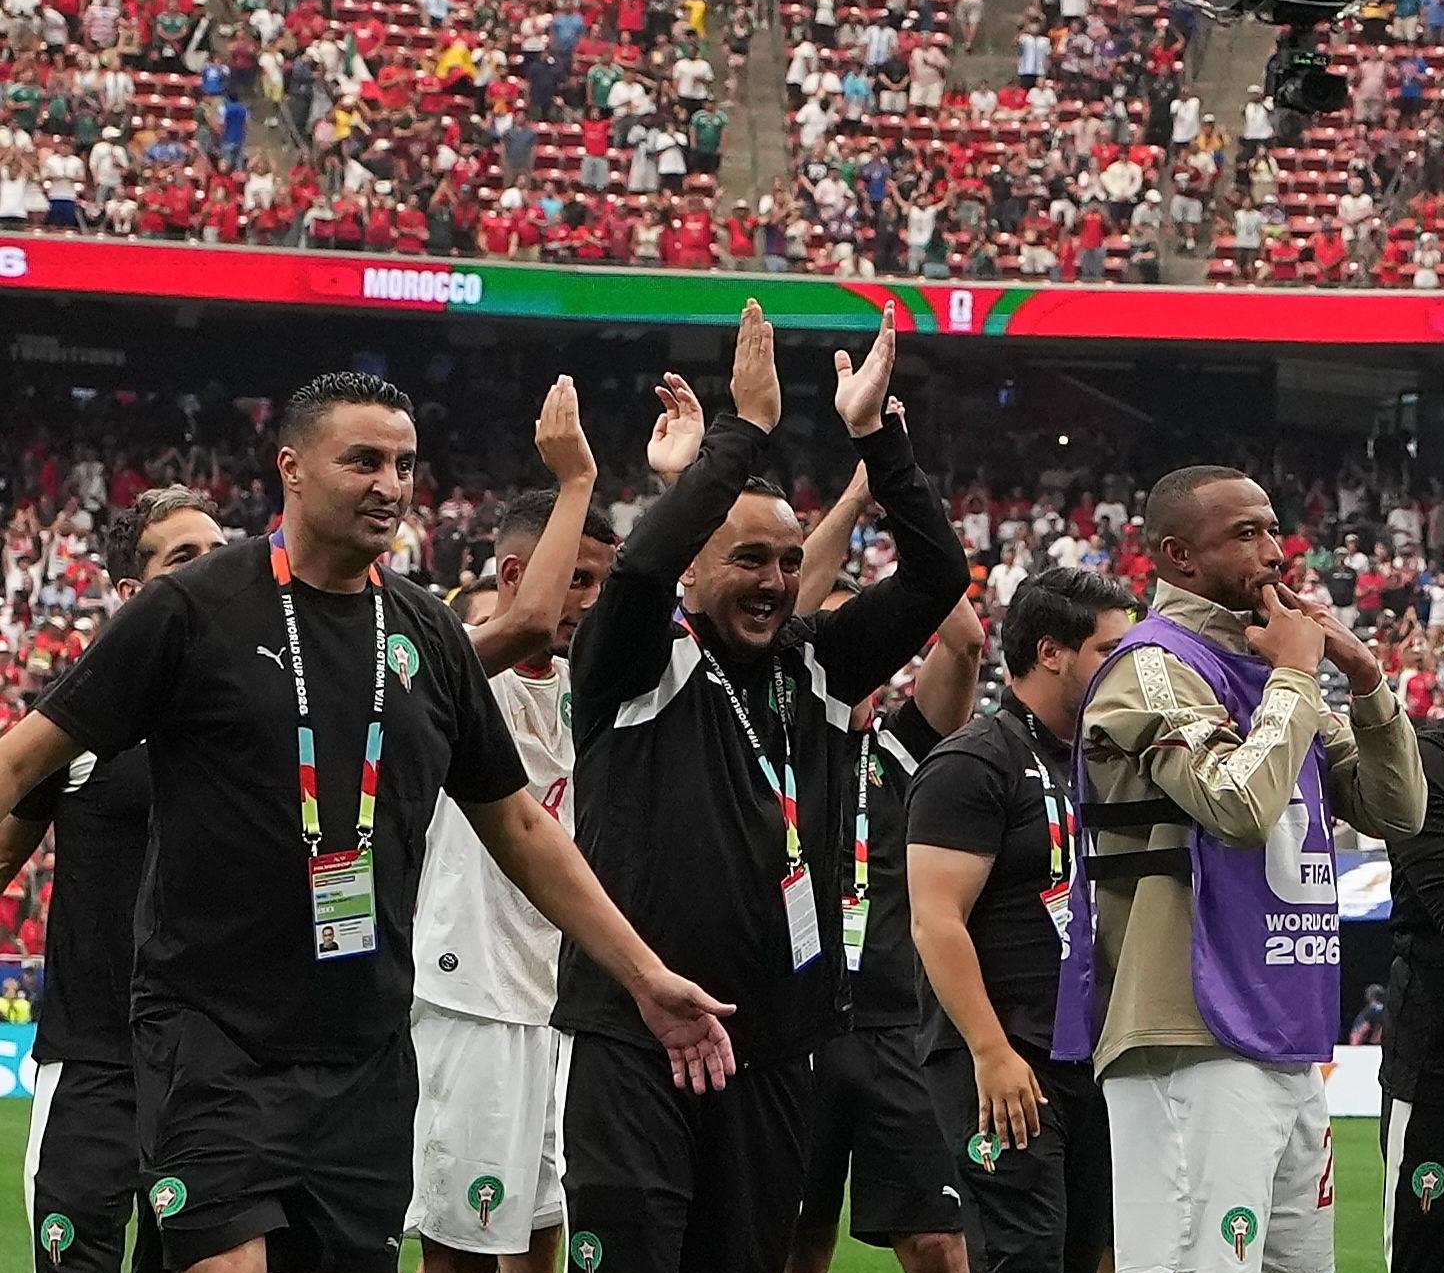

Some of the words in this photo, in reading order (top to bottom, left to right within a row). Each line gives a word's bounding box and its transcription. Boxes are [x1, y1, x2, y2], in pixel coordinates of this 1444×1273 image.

[363, 267, 483, 305] MOROCCO
[281, 594, 295, 617] FIFA
[286, 616, 301, 655] WORLD
[376, 629, 386, 649] CUP
[291, 654, 304, 677] CUP
[375, 649, 386, 688] WORLD
[295, 677, 309, 717] 2026
[373, 688, 385, 712] FIFA
[721, 677, 735, 697] CUP
[730, 695, 751, 731] WORLD
[1300, 864, 1331, 885] FIFA
[1265, 935, 1341, 965] 2026
